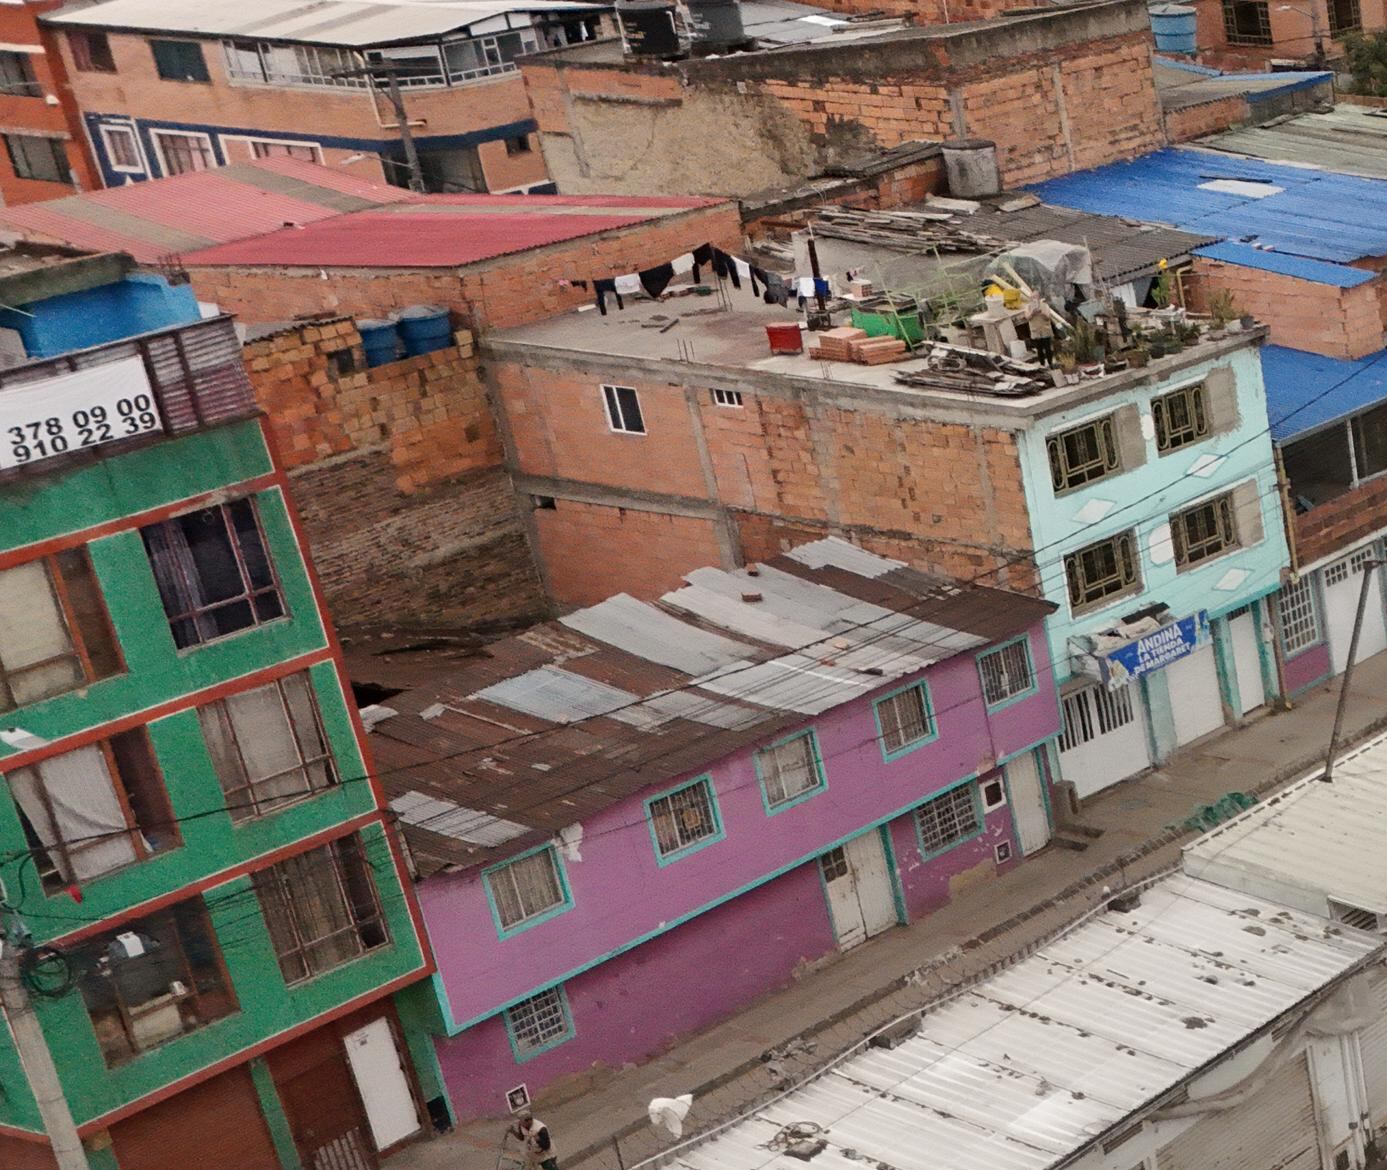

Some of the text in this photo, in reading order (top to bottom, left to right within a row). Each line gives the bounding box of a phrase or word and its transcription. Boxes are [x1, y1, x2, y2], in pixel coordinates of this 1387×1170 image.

[8, 394, 150, 445] 378 09 00
[13, 411, 156, 463] 910 22 39
[1137, 623, 1183, 656] ANDINA
